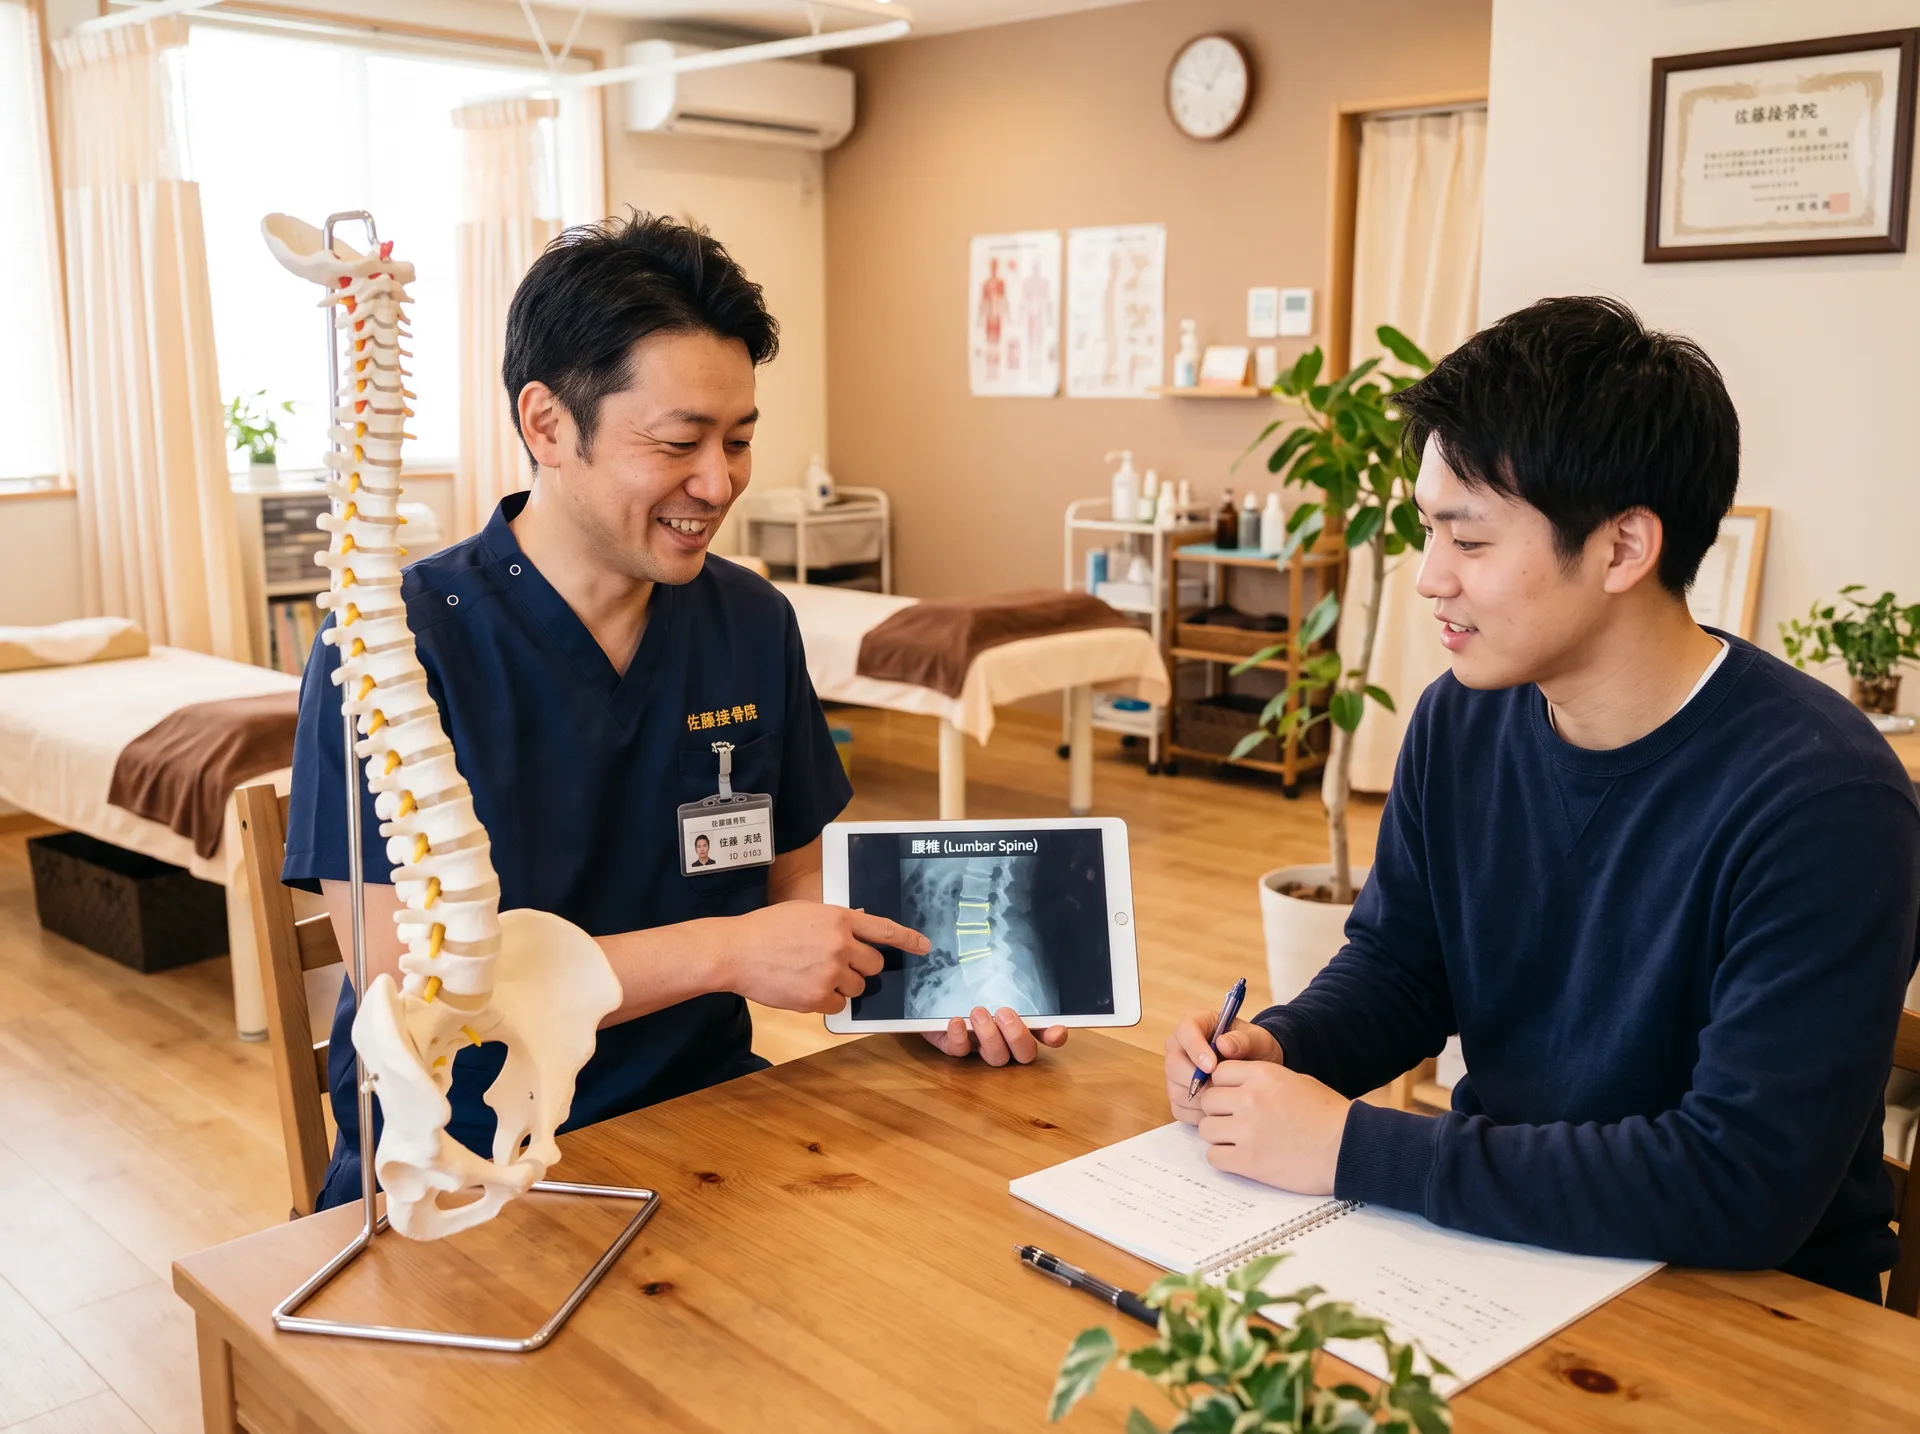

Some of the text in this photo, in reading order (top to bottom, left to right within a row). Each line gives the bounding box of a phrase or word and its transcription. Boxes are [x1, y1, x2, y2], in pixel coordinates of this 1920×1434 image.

[687, 703, 758, 731] 佐藤接骨院
[743, 849, 762, 858] 0103
[943, 839, 996, 854] (Lumbar
[998, 838, 1038, 855] Spine)
